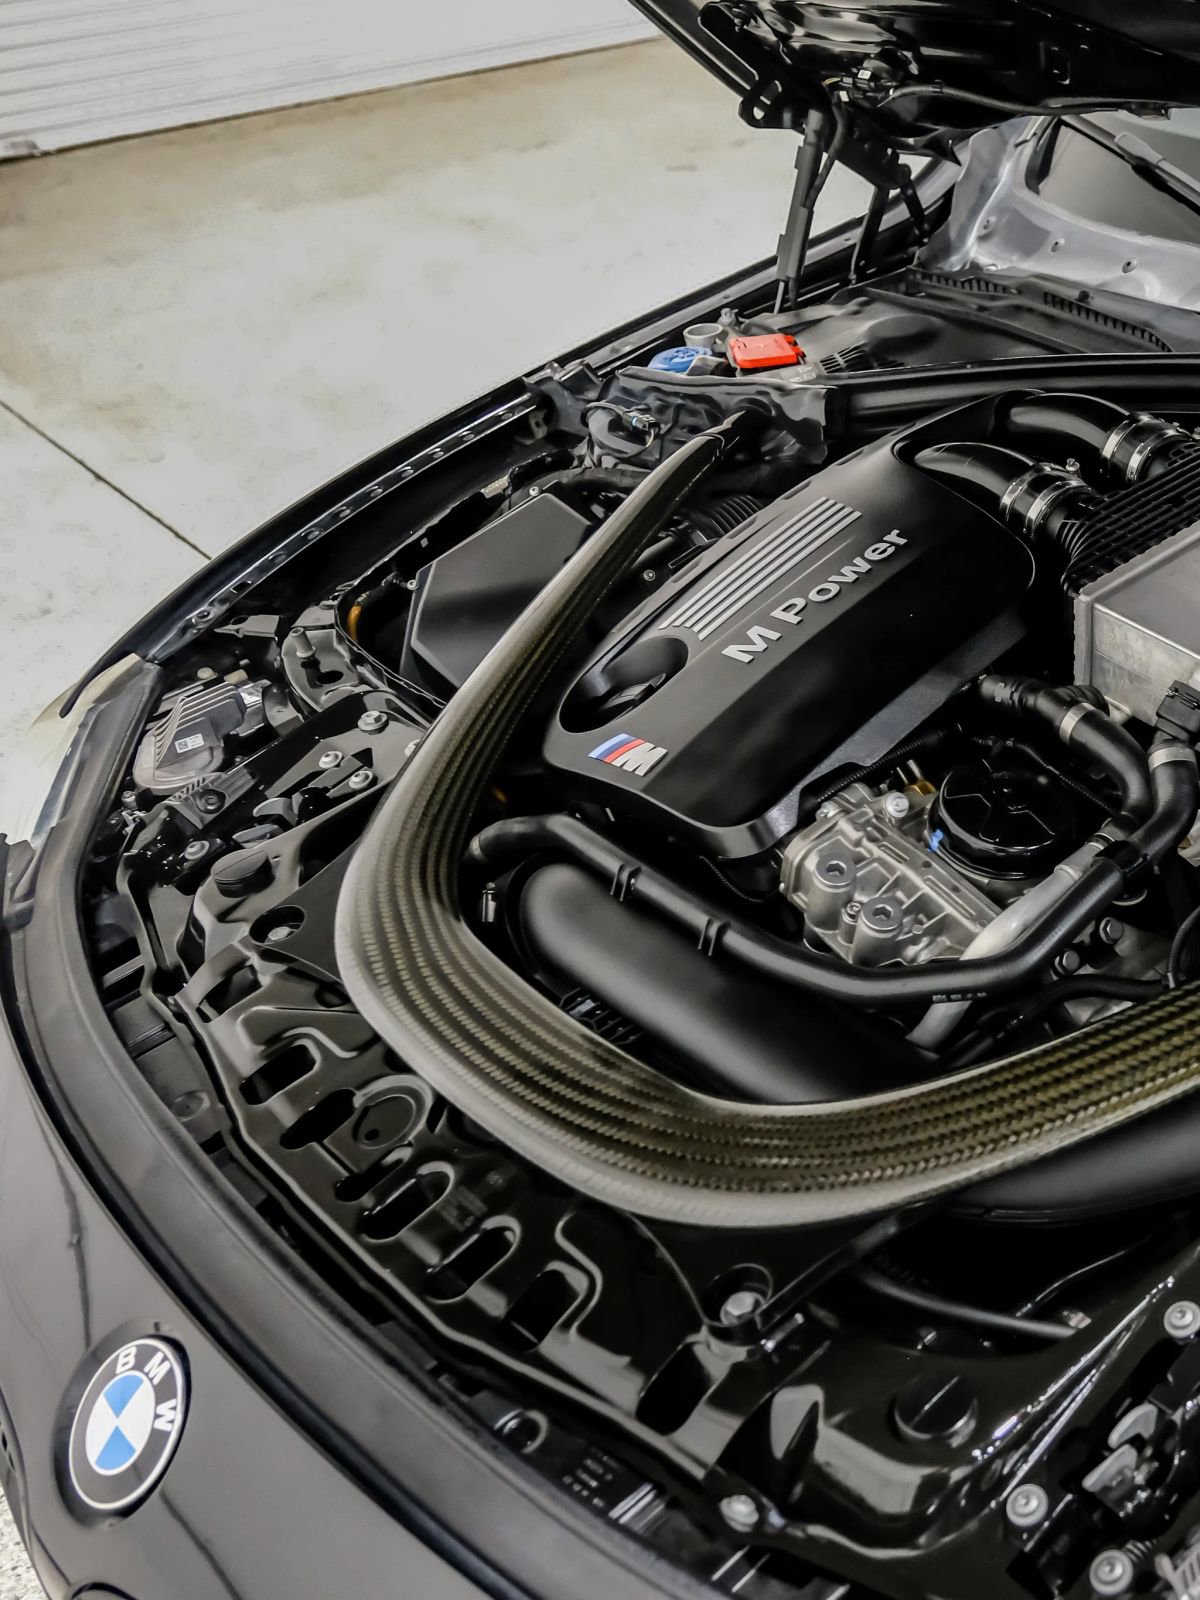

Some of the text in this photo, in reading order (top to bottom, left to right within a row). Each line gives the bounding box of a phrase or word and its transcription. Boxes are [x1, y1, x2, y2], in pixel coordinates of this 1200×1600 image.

[721, 528, 909, 664] M Power
[607, 740, 668, 777] M
[116, 1346, 178, 1433] BMW
